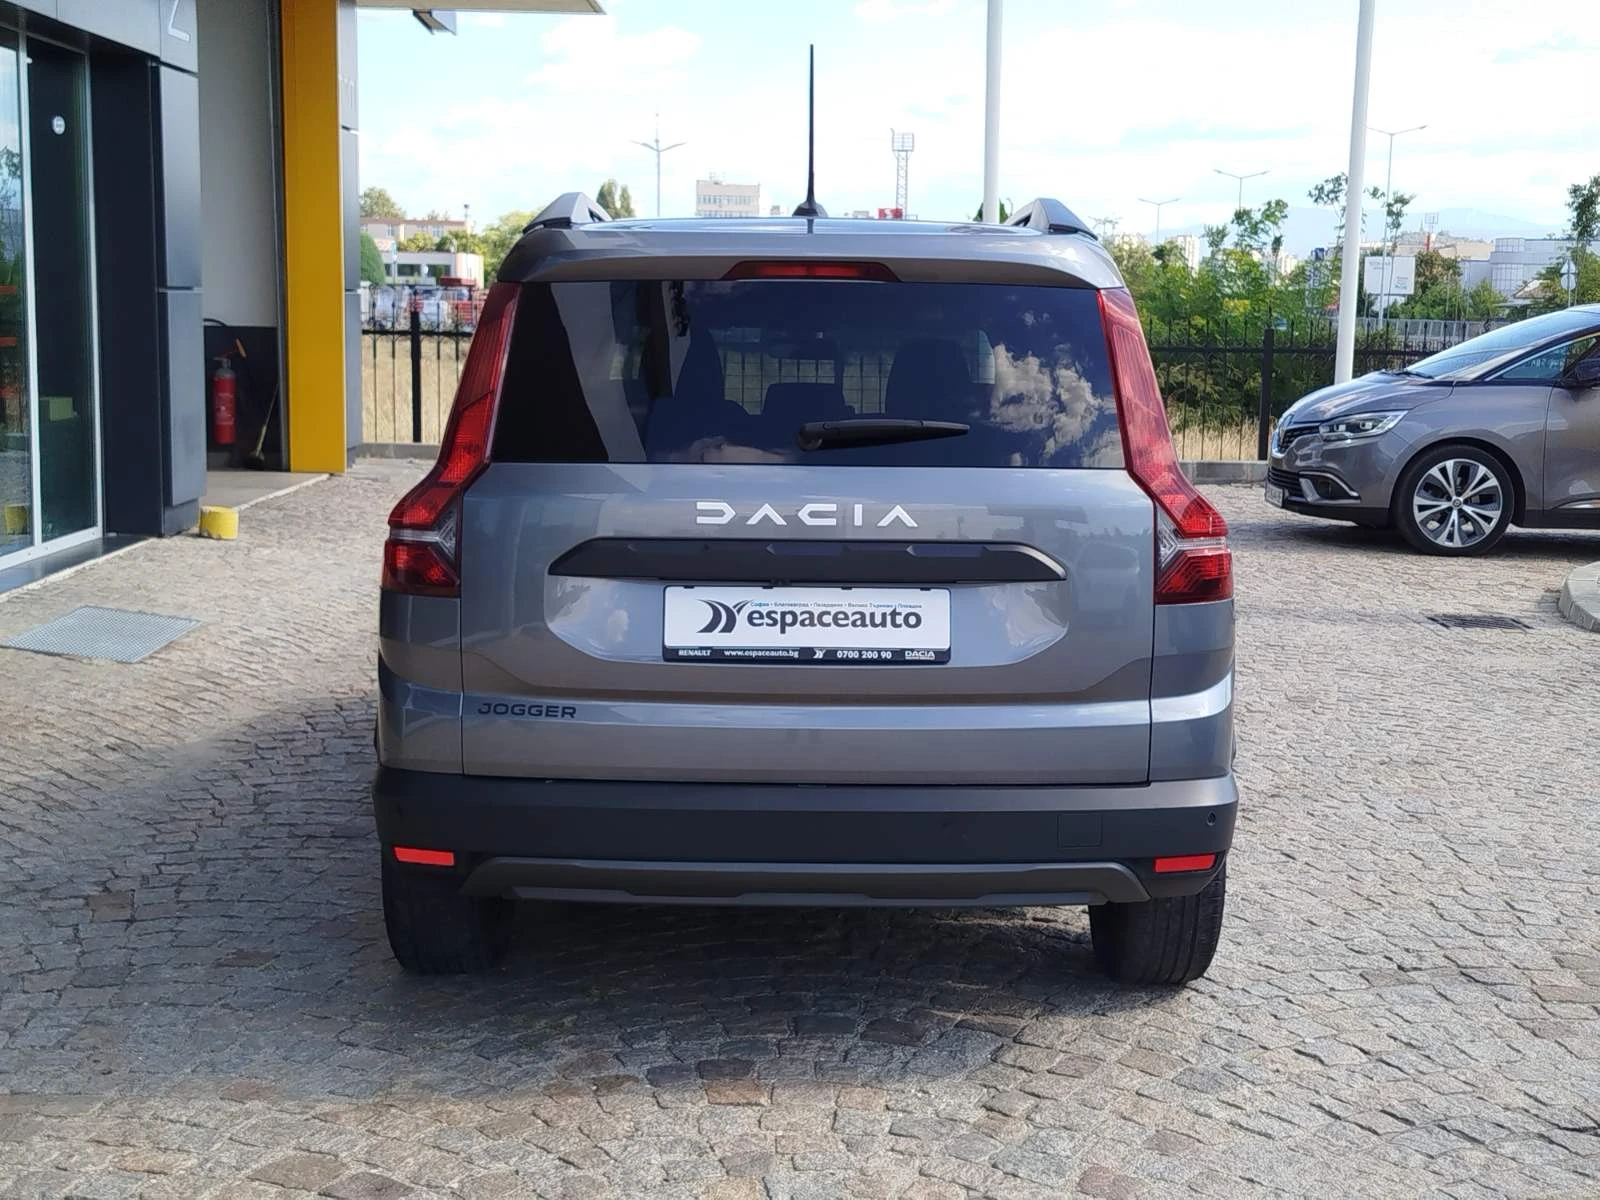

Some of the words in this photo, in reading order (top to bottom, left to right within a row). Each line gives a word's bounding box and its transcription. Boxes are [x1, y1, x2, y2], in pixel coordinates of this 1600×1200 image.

[696, 501, 919, 527] DACIA
[747, 606, 922, 634] espaceauto
[723, 649, 799, 658] www.espaceauto.bg
[836, 650, 859, 658] 0700
[861, 650, 878, 659] 200
[880, 651, 892, 659] 90
[904, 650, 935, 658] DACIA
[478, 703, 577, 718] JOGGER
